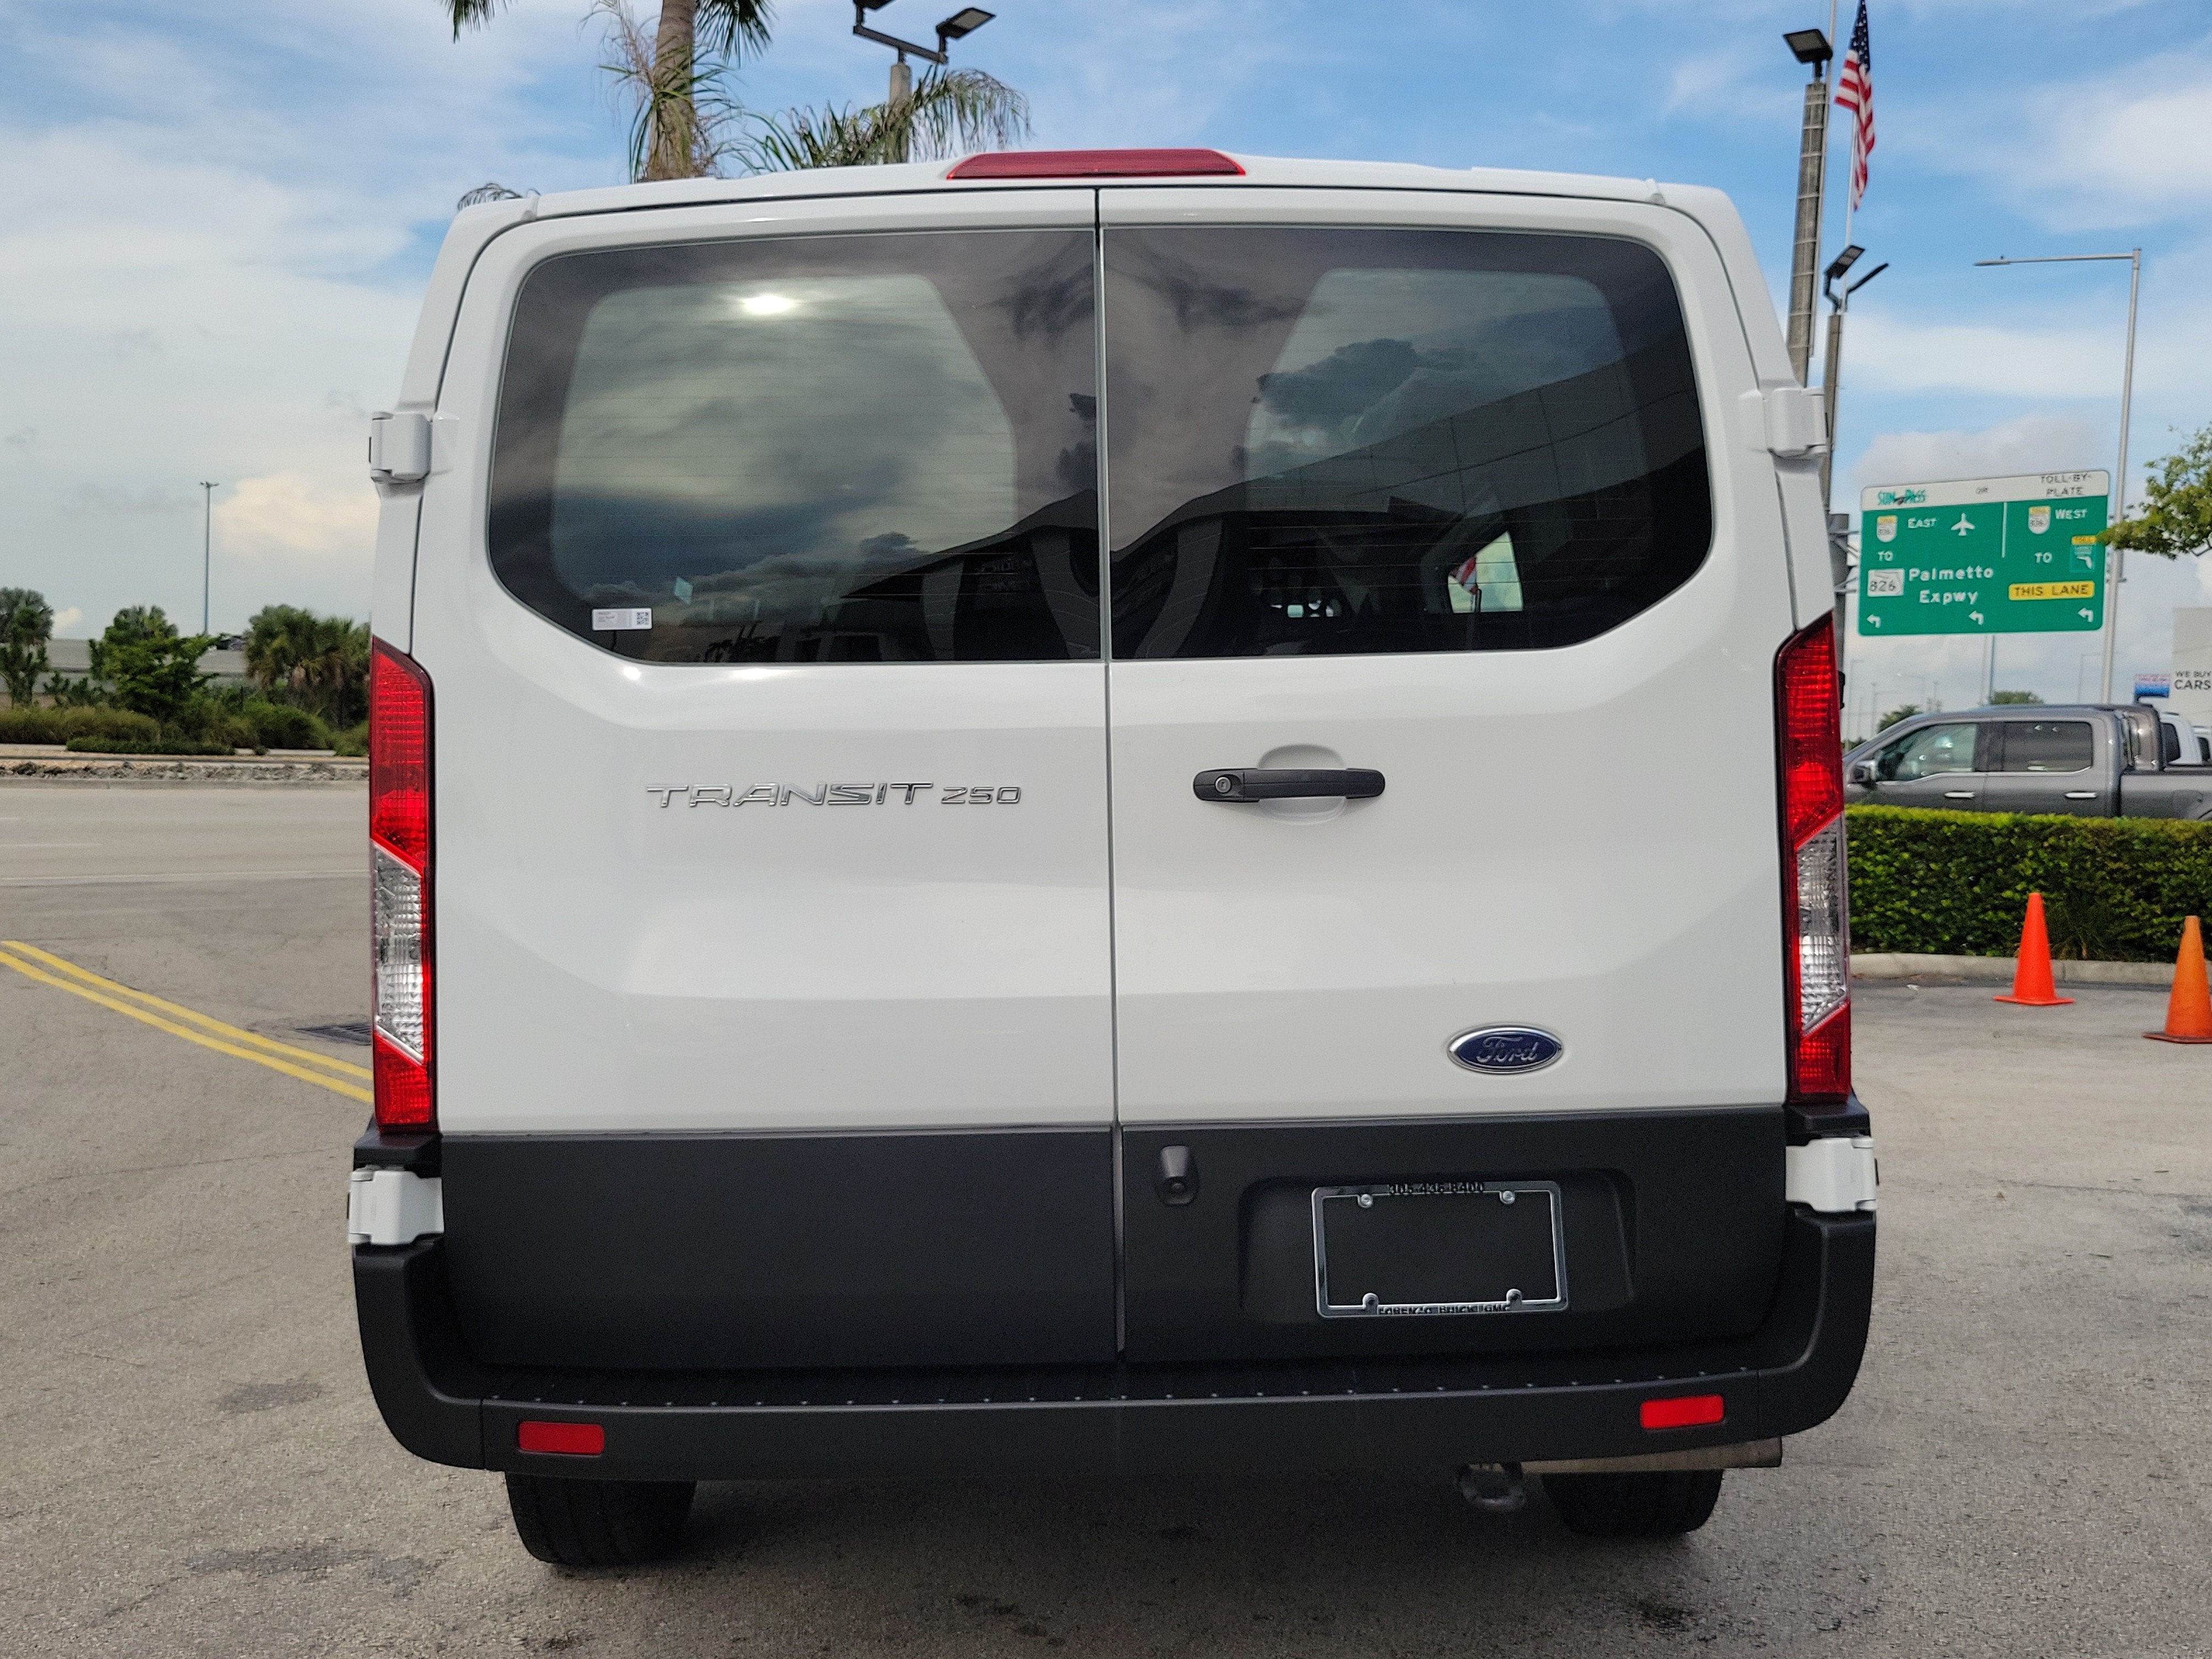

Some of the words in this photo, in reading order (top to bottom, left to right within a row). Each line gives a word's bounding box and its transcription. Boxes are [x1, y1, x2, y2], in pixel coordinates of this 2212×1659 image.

[2055, 508, 2087, 520] WEST
[1908, 517, 1937, 528] EAST
[1877, 551, 1893, 561] TO
[2035, 552, 2052, 563] TO
[1909, 565, 1994, 582] Palmetto
[1869, 580, 1895, 591] 826
[2014, 586, 2044, 596] THIS
[2052, 584, 2089, 595] LANE
[1920, 590, 1978, 605] Expwy
[2174, 680, 2211, 690] CARS
[646, 781, 933, 807] TRANSIT
[941, 786, 1022, 805] 250
[1476, 1036, 1538, 1062] Ford
